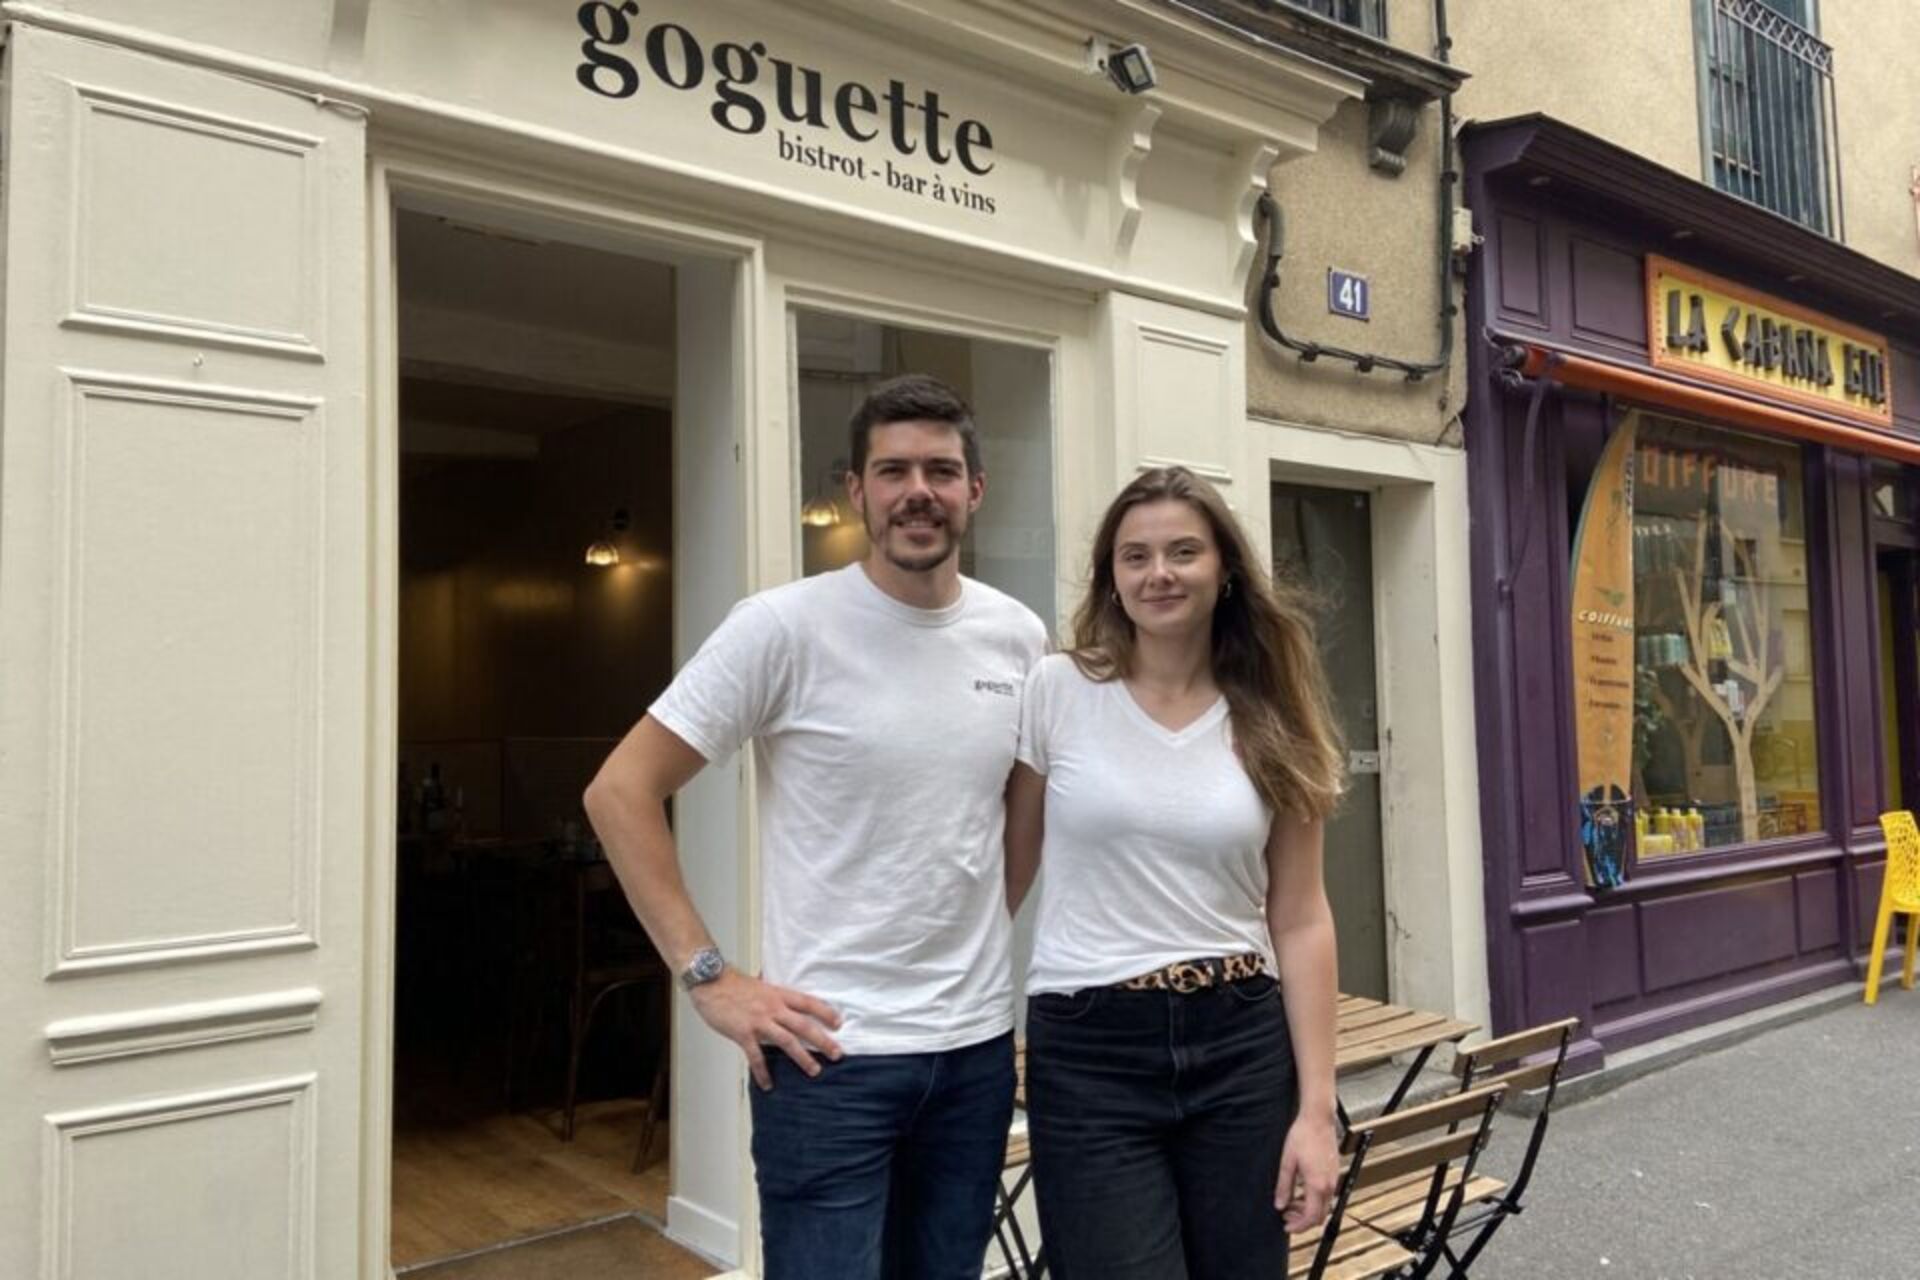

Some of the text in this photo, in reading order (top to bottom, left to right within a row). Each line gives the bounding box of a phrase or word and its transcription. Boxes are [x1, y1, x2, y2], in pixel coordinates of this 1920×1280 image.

[576, 0, 996, 177] goguette
[778, 130, 866, 180] bistrot
[886, 160, 928, 197] bar
[932, 172, 946, 201] à
[949, 183, 997, 215] vins
[1340, 277, 1361, 313] 41
[1666, 289, 1708, 353] LA
[1720, 305, 1834, 387] CABANA
